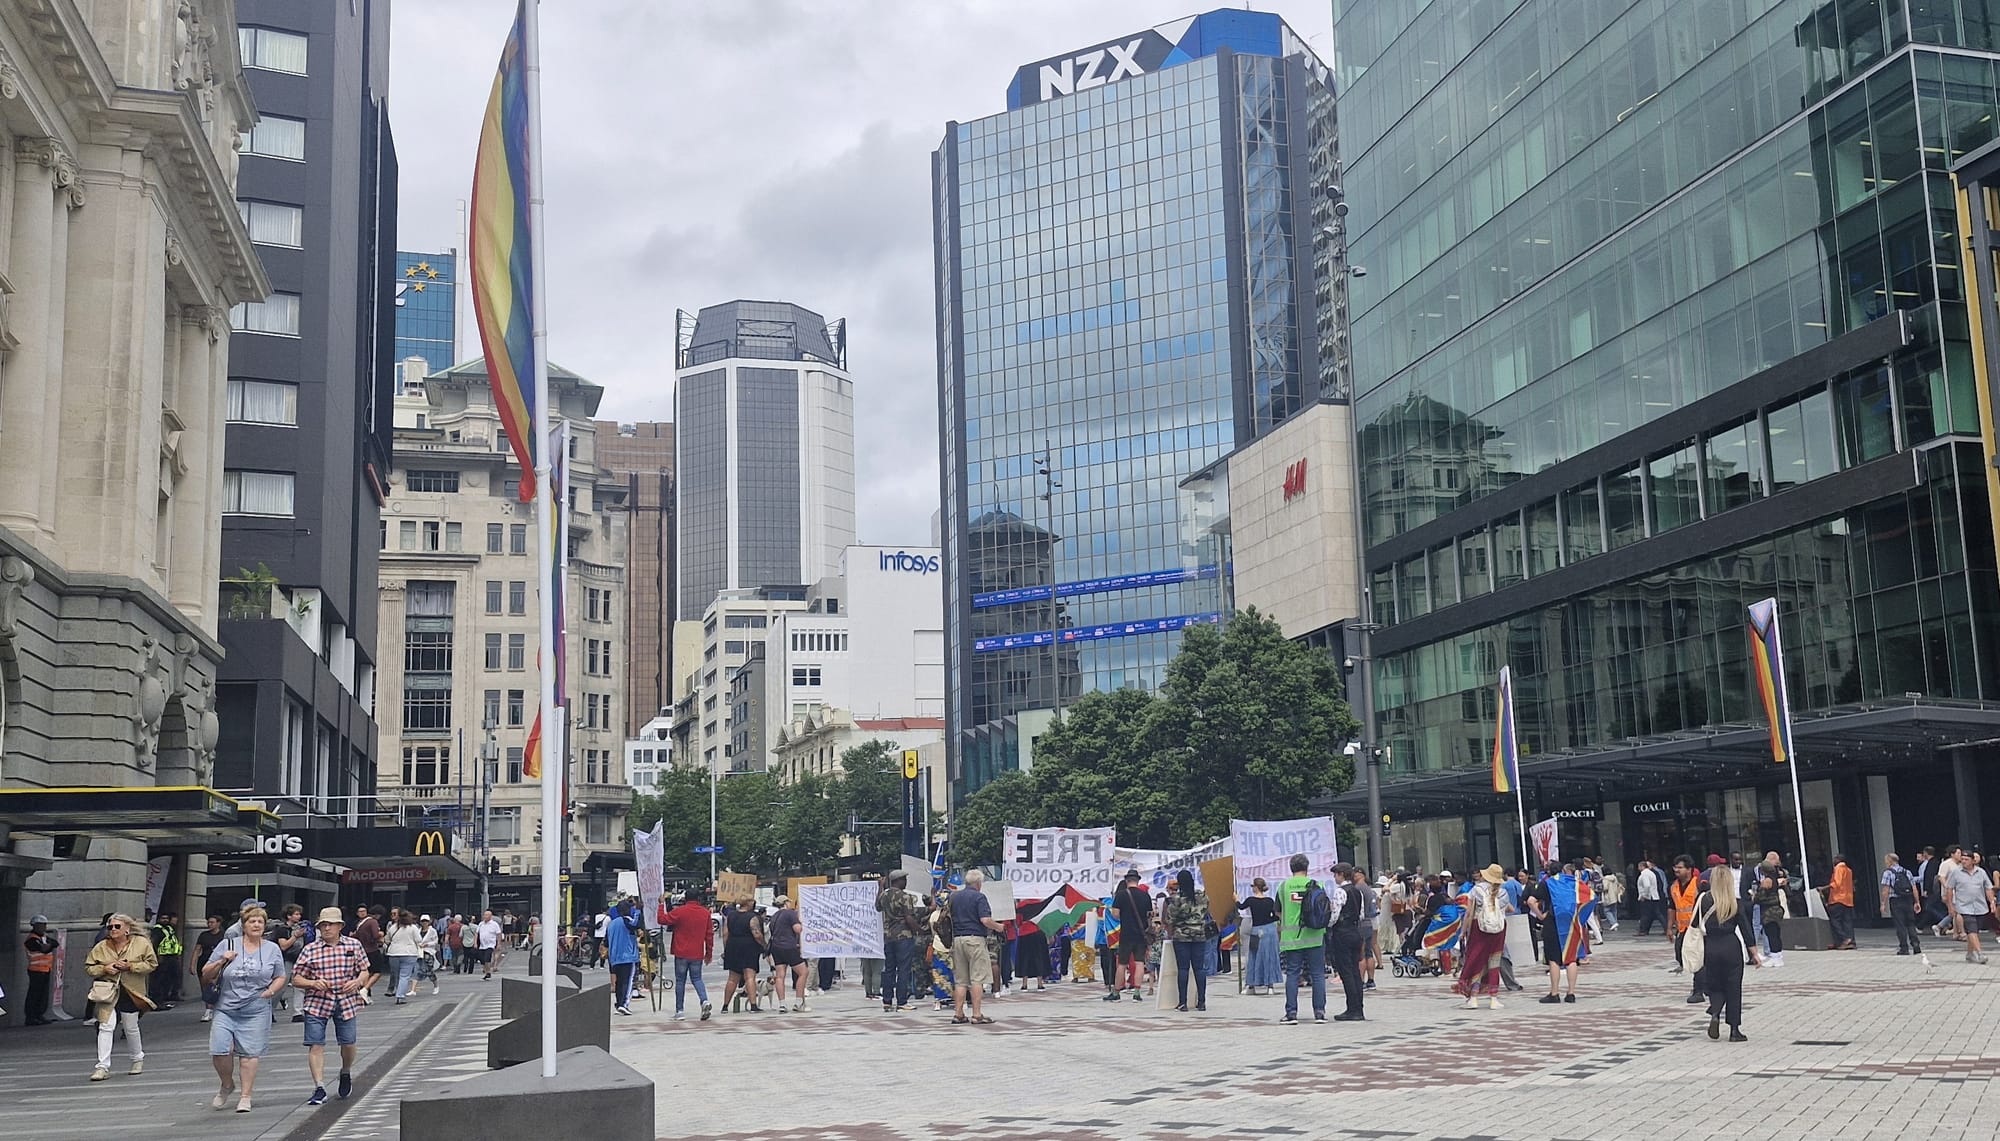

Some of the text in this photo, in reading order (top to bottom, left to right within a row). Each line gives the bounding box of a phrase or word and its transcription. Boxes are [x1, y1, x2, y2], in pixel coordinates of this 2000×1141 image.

[1040, 38, 1145, 102] NZX
[880, 550, 939, 576] Infosys
[1633, 801, 1670, 813] COACH
[1551, 810, 1595, 818] COACH
[348, 868, 424, 881] McDonald's
